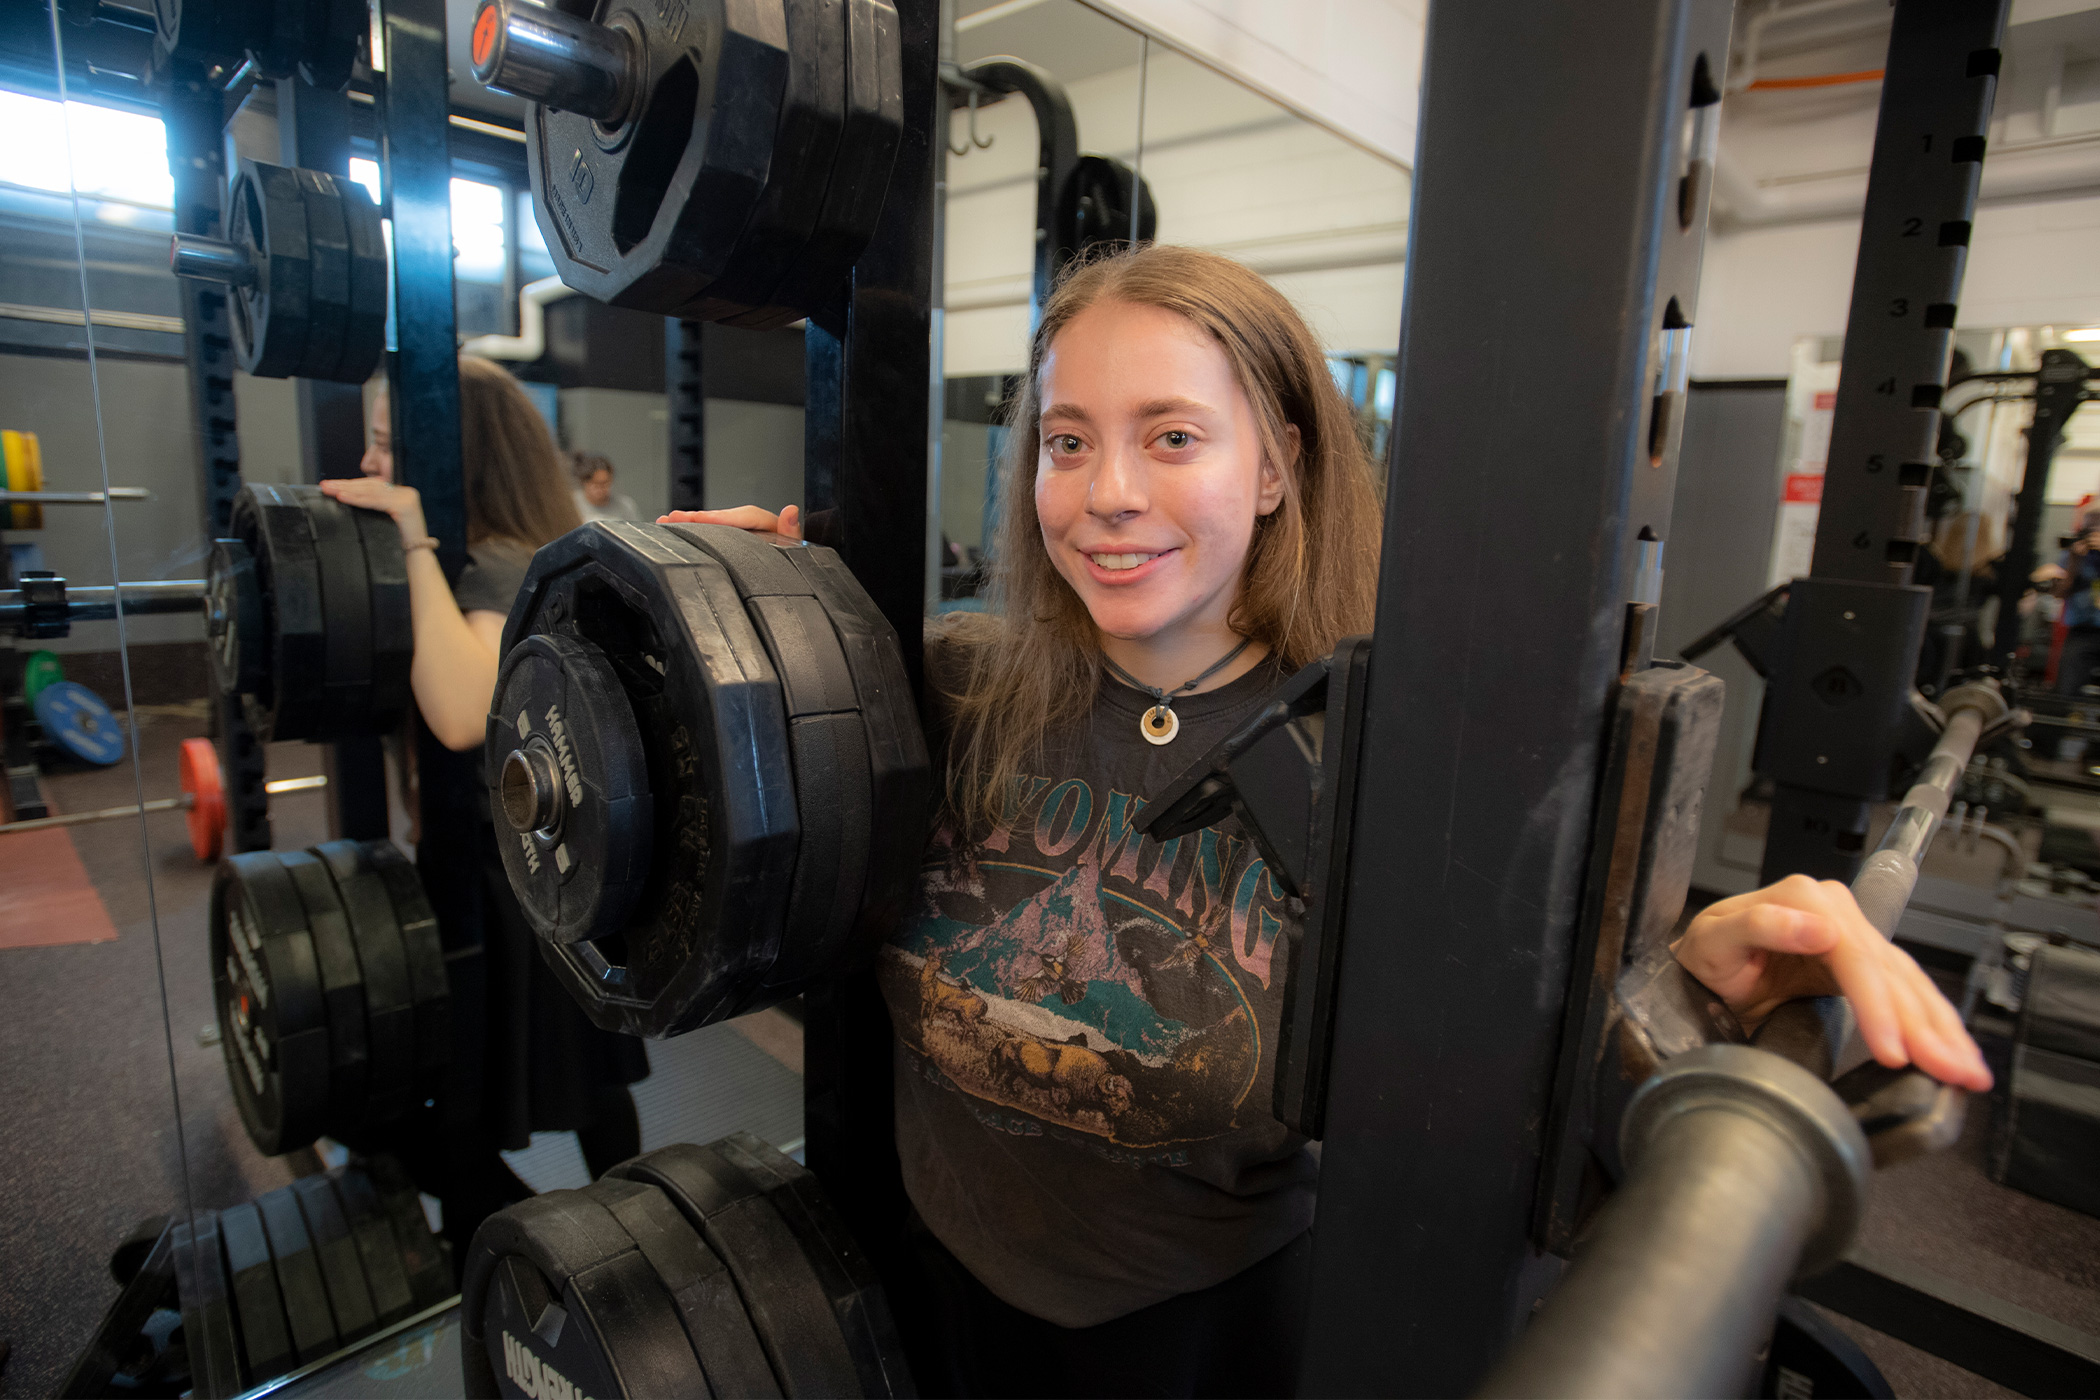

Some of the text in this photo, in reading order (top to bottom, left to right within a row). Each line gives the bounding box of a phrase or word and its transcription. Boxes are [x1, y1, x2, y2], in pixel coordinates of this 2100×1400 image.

[1921, 133, 1934, 153] 1
[1902, 216, 1923, 237] 2
[1889, 297, 1909, 318] 3
[1877, 375, 1897, 396] 4
[1866, 453, 1885, 474] 5
[1852, 530, 1871, 550] 6
[544, 704, 583, 808] HAMMER
